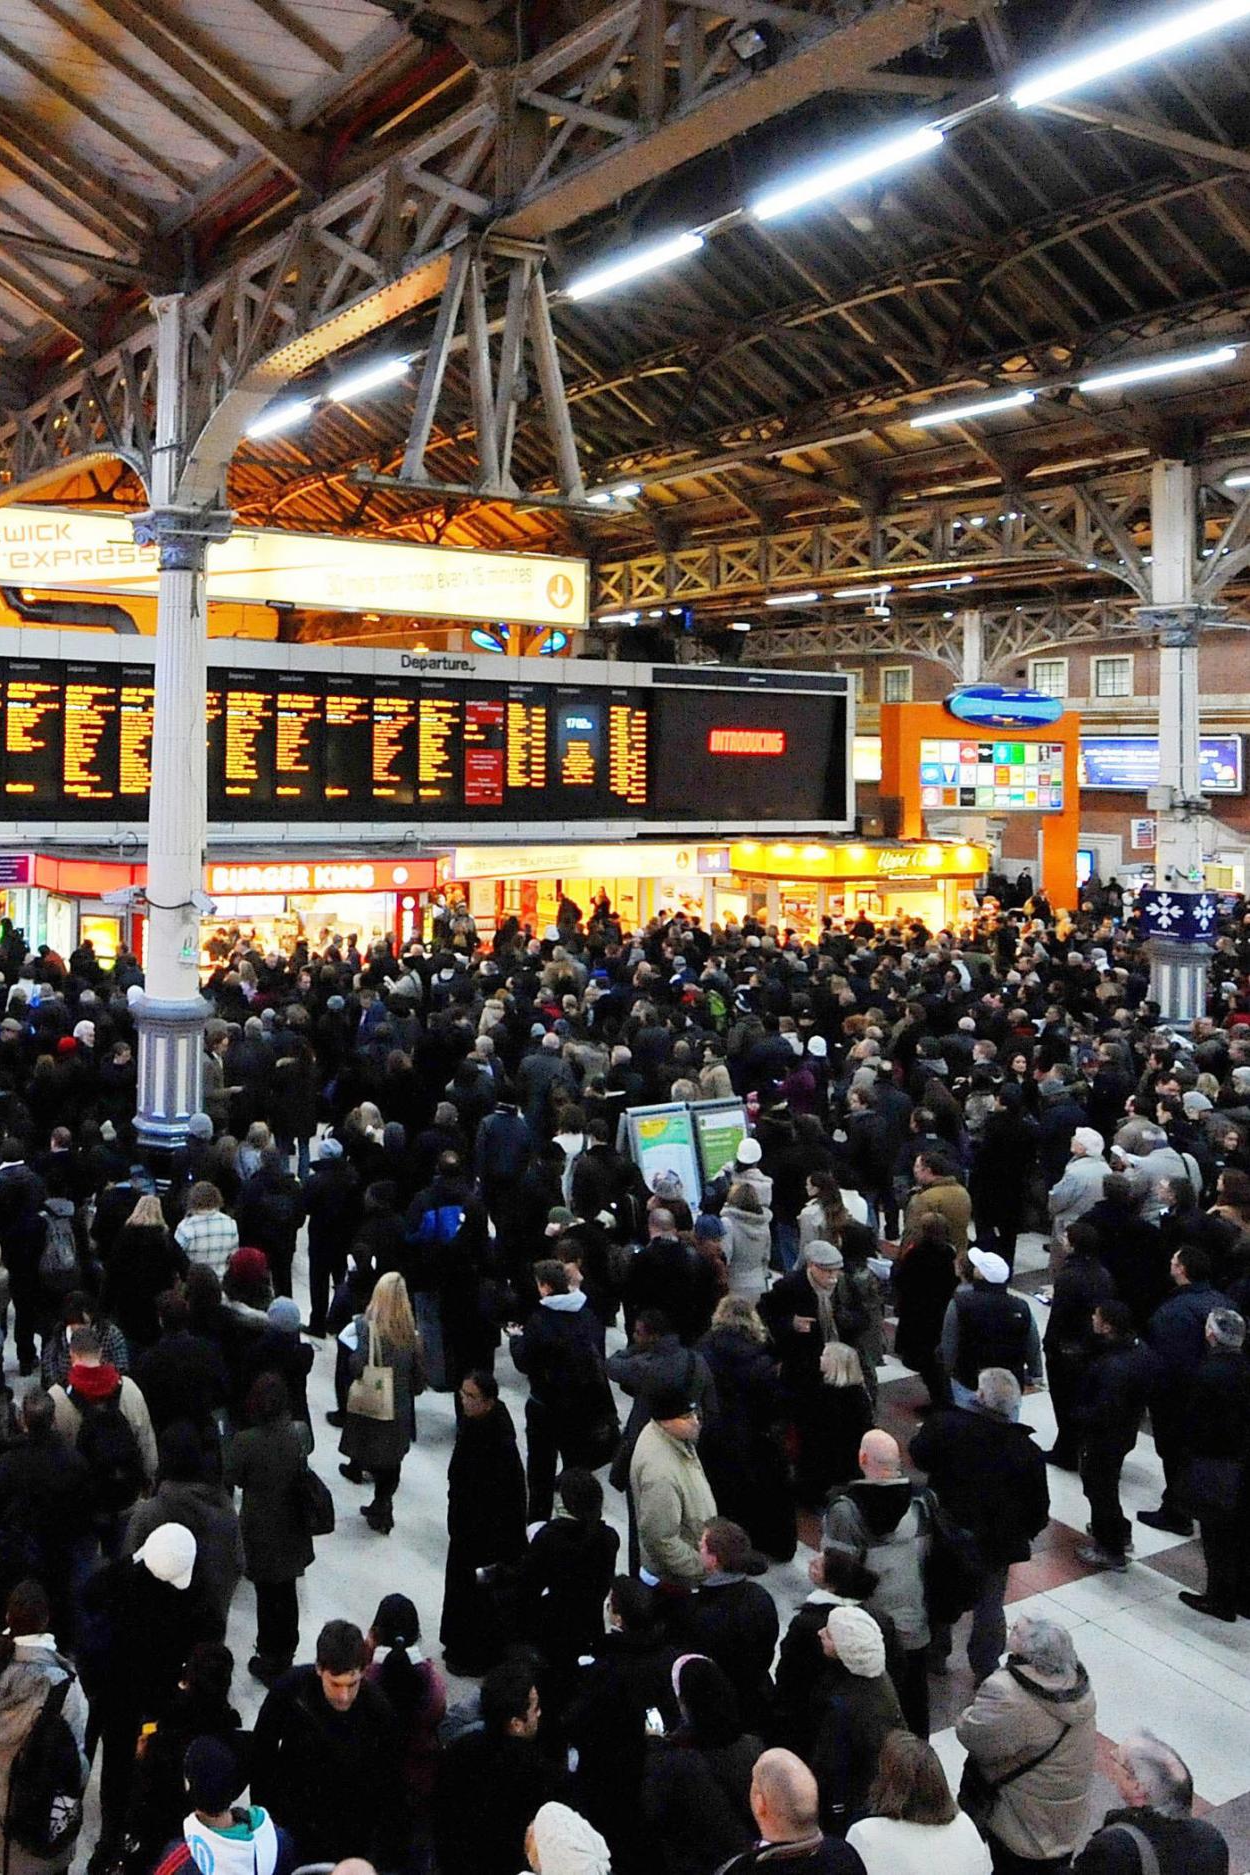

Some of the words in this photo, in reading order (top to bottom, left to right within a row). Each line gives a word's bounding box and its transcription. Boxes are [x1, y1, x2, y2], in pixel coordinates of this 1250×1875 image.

[710, 730, 784, 753] INTRODUCING
[212, 865, 310, 890] BURGER
[314, 864, 375, 888] KING
